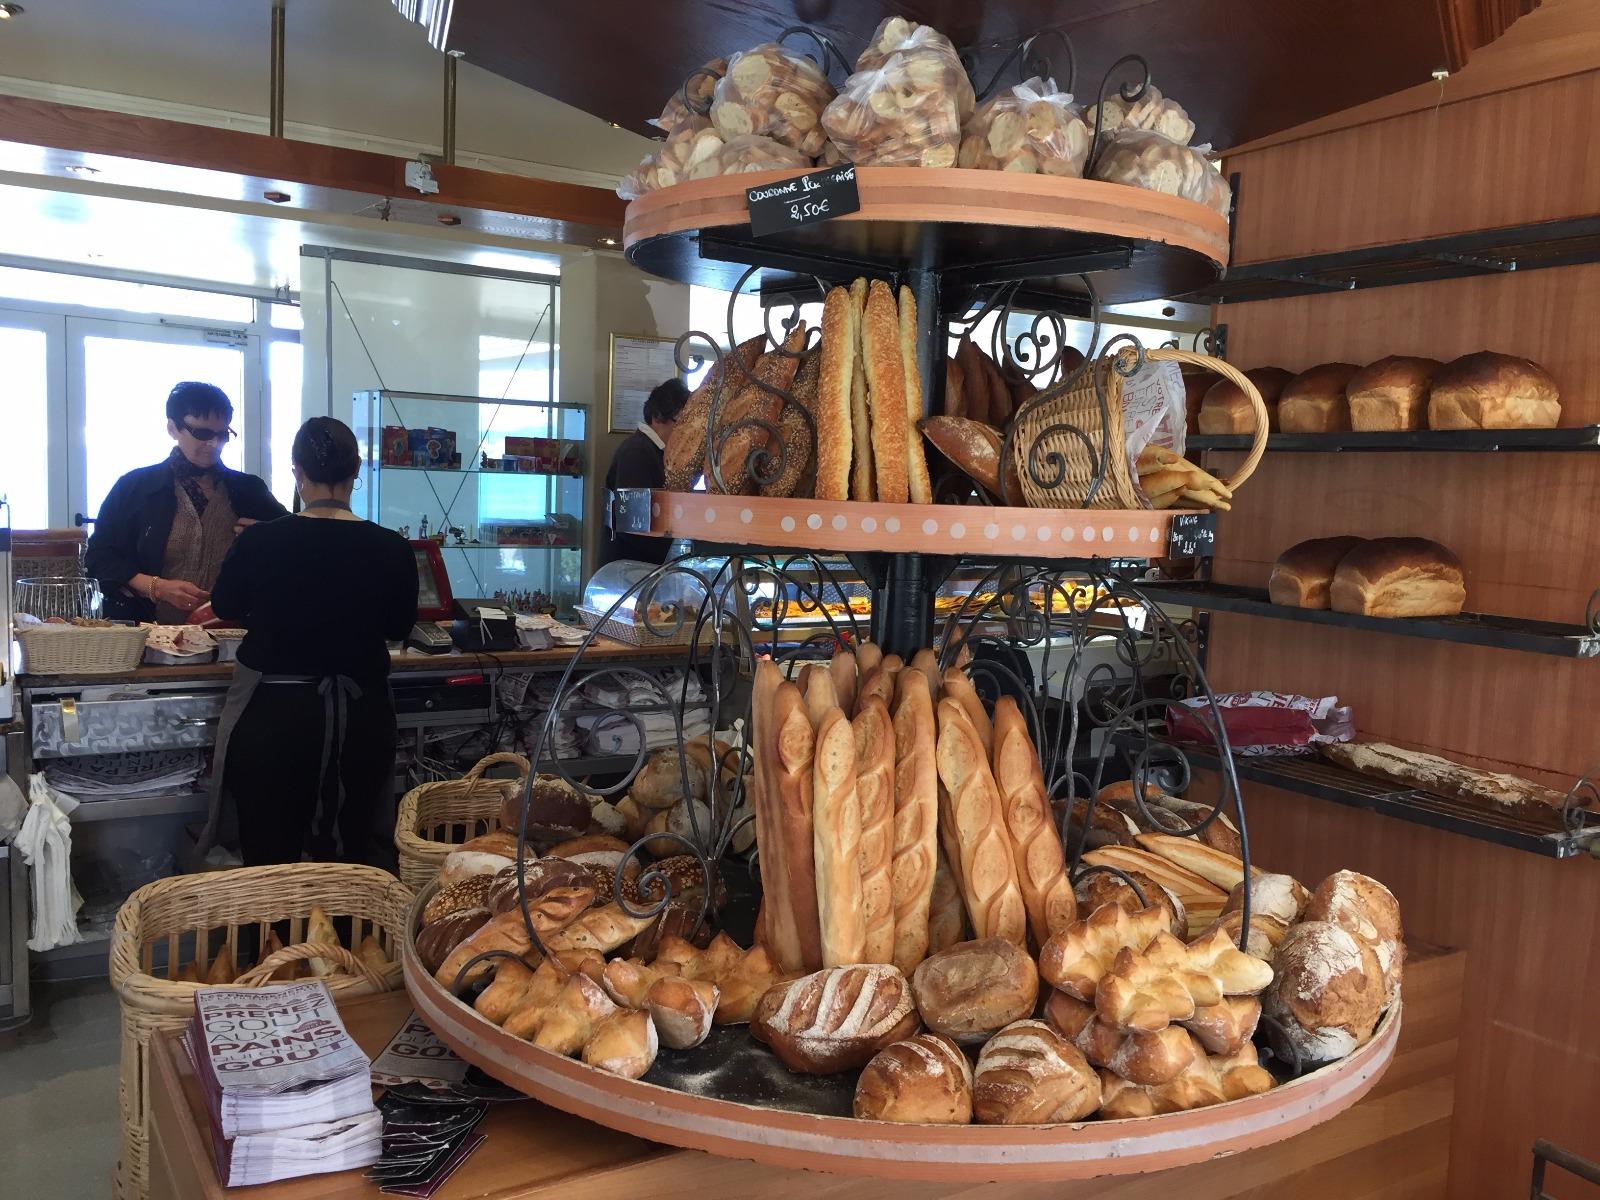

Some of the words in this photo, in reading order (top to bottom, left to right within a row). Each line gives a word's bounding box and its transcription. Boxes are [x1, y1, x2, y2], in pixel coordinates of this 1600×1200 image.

[790, 199, 830, 222] 2,50€
[204, 998, 327, 1020] PRENEZ
[205, 1005, 326, 1033] GOUT
[210, 1030, 280, 1043] AUX
[211, 1025, 342, 1056] PAINS
[216, 1037, 348, 1071] GOUT
